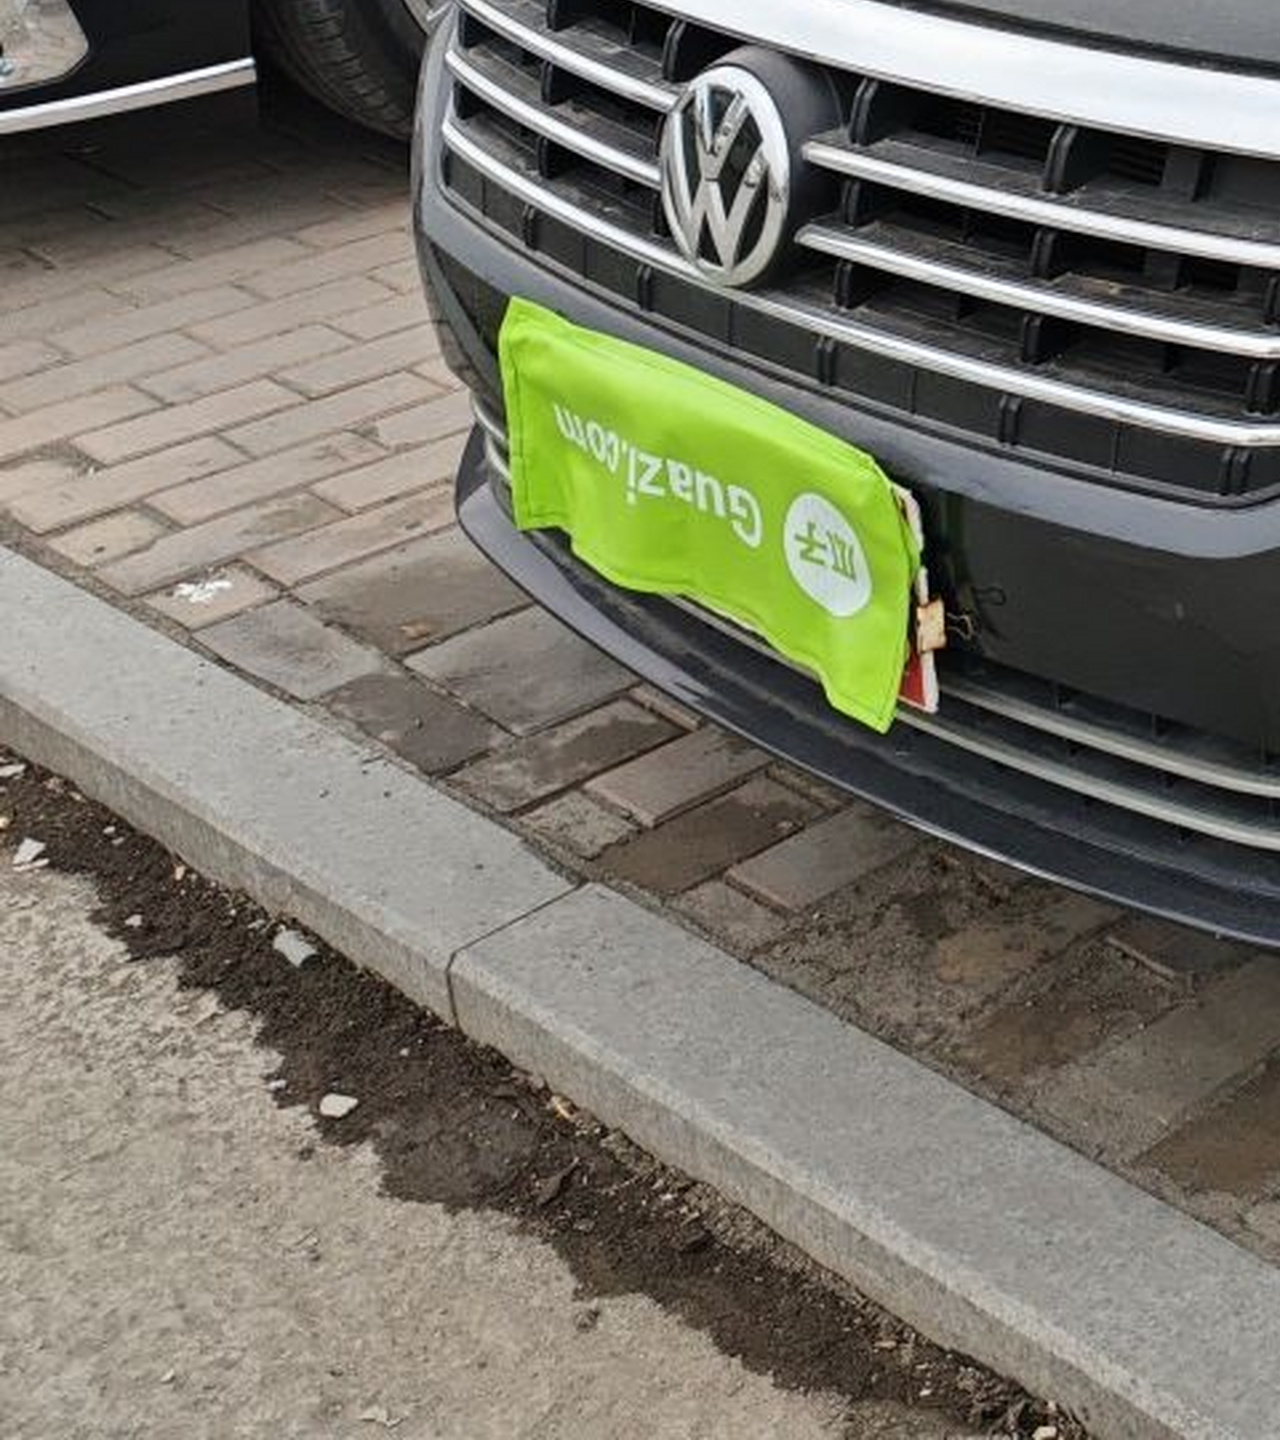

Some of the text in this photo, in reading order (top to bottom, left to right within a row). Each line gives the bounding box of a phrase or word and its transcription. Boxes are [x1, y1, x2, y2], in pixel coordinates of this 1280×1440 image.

[664, 70, 785, 284] VW
[553, 402, 858, 584] 瓜子 Guazi.com
